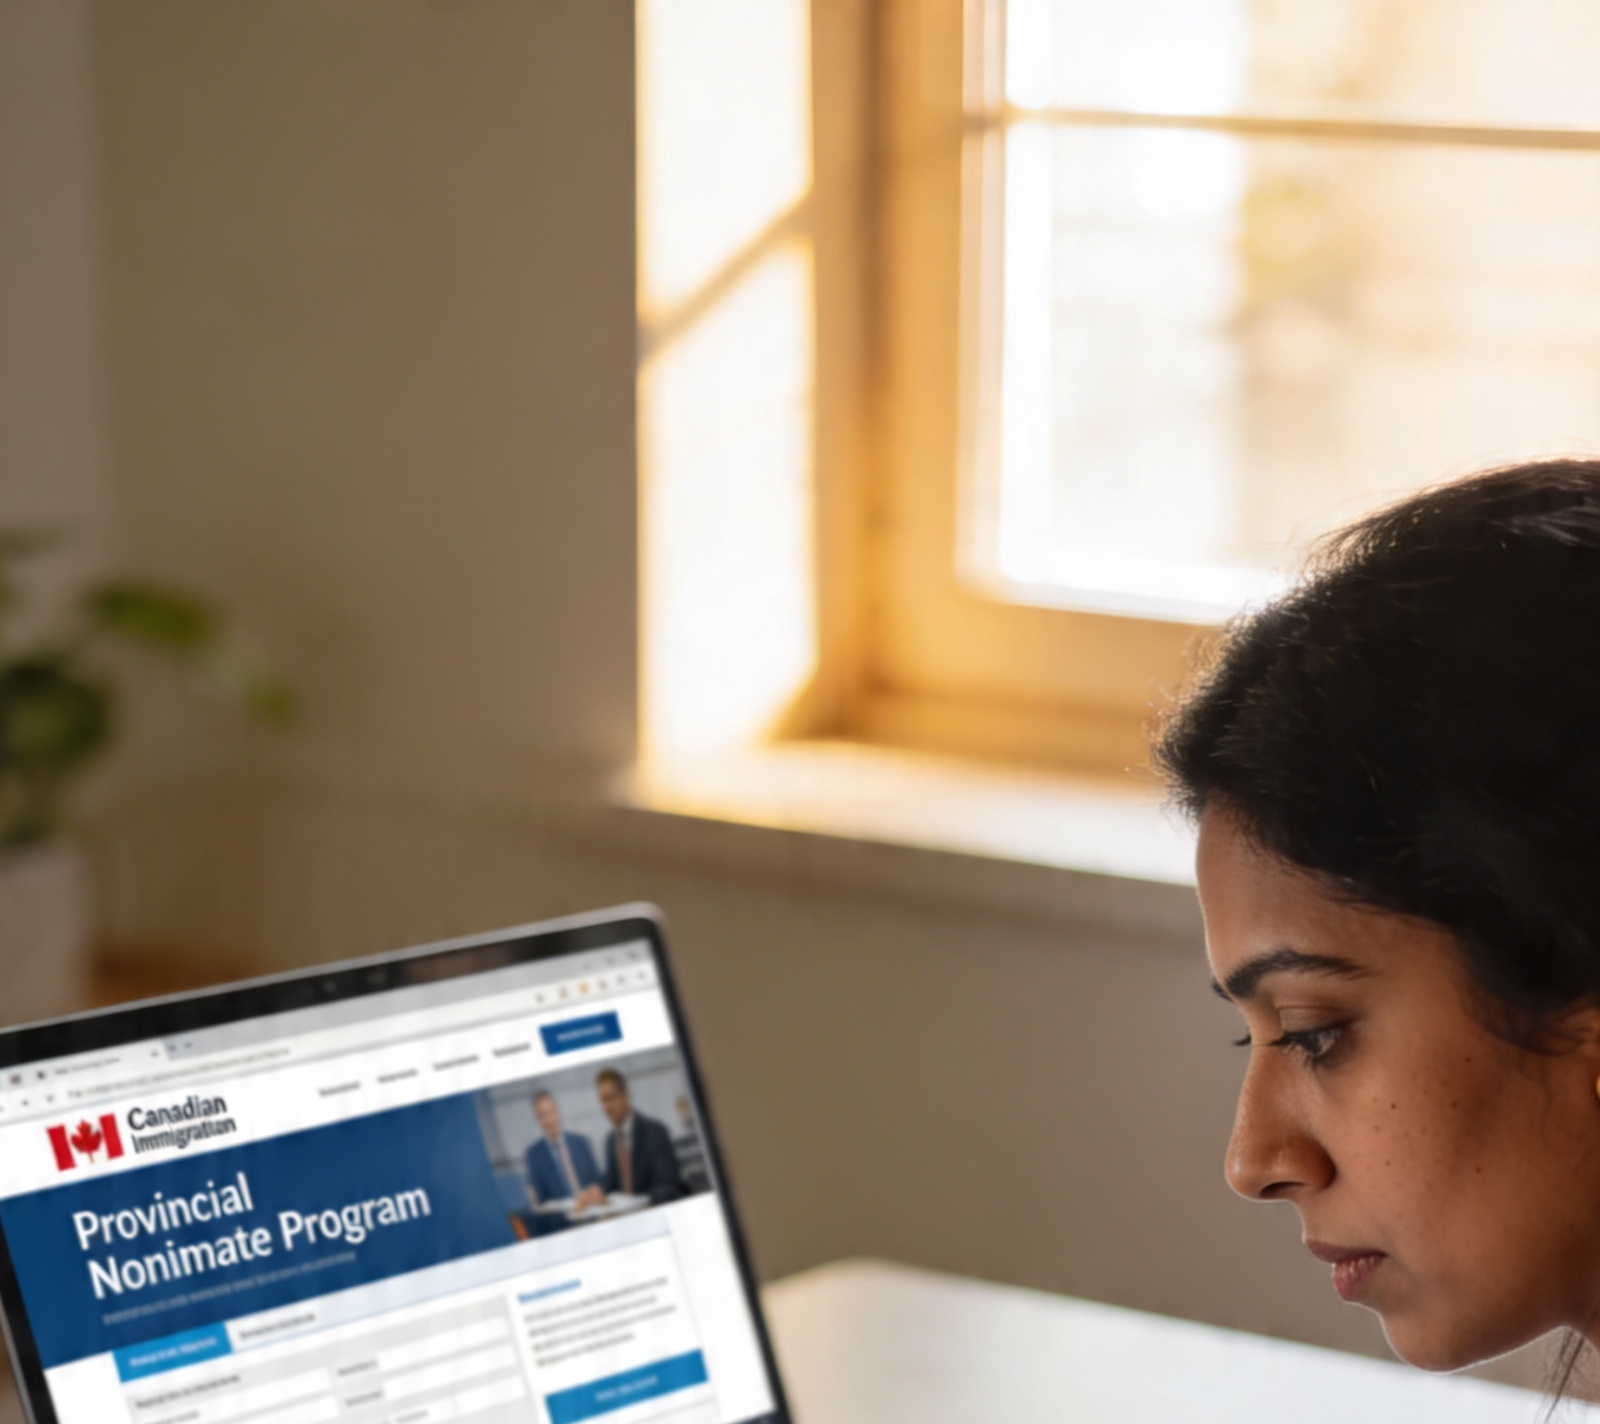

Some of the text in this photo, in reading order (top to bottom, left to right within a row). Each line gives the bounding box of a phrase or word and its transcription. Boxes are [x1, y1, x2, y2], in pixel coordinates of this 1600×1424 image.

[127, 1095, 228, 1131] Canadian
[72, 1171, 254, 1251] Provincial
[87, 1226, 273, 1300] Nonimate
[277, 1187, 432, 1251] Program
